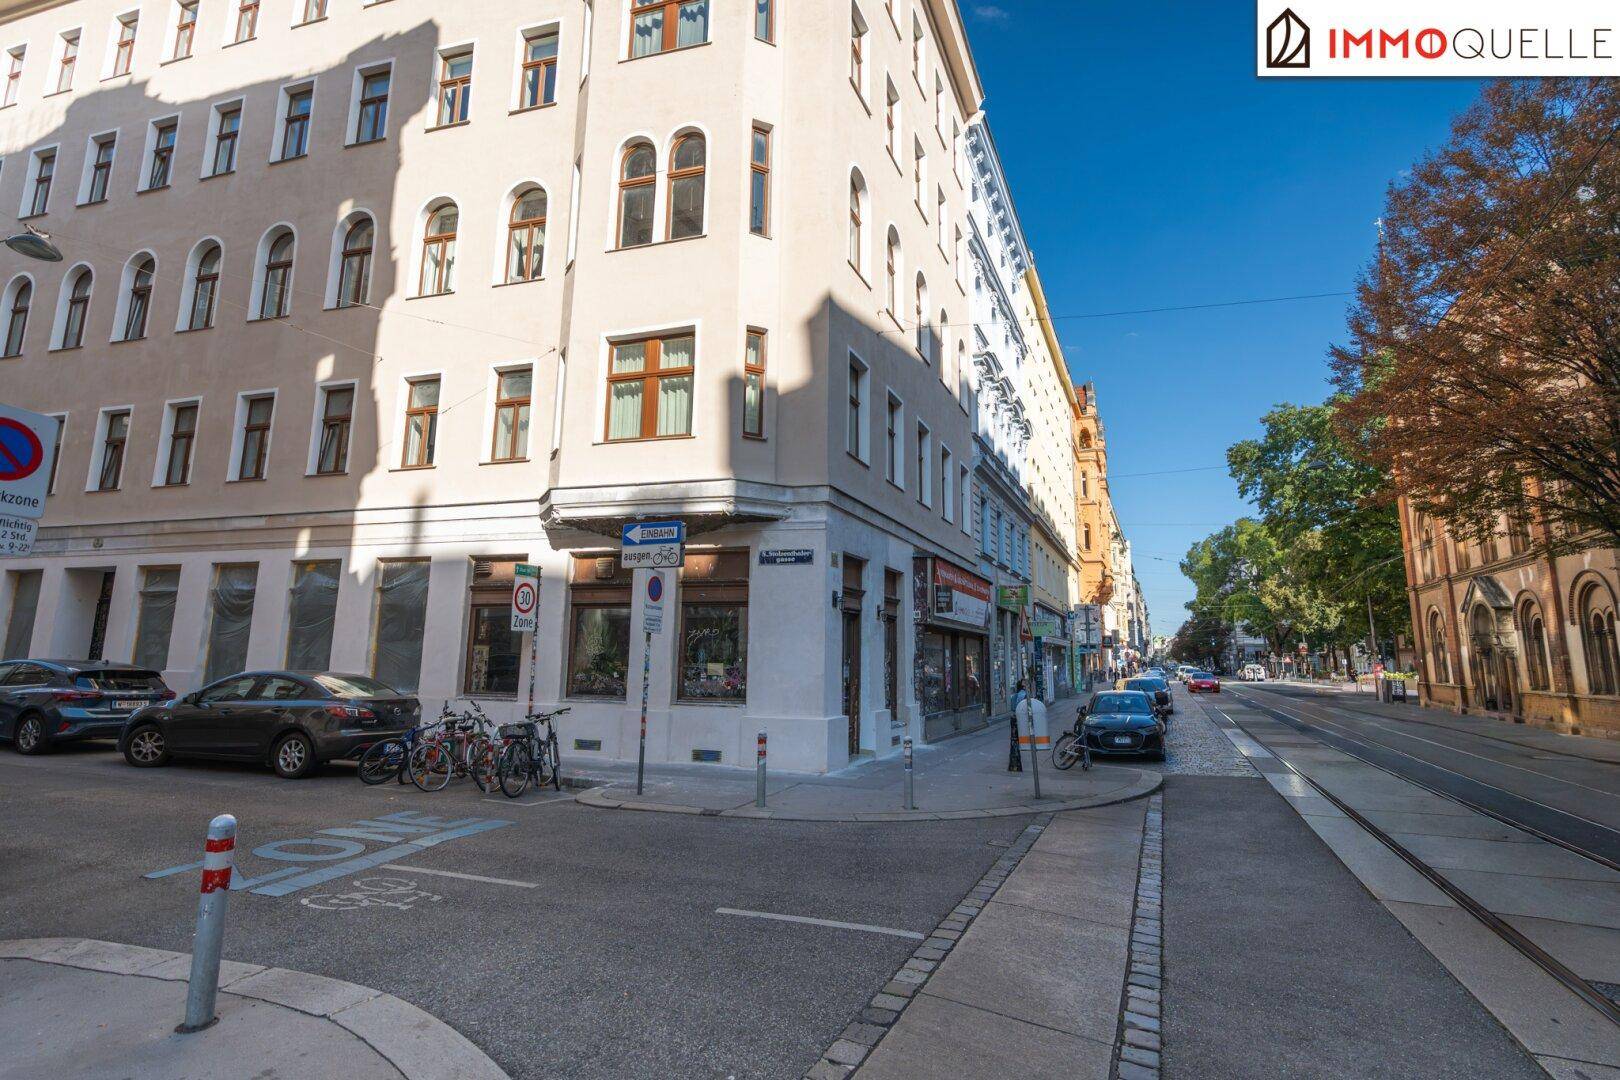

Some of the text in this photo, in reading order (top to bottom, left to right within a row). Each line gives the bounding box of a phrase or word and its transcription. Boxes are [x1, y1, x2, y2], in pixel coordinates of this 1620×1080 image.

[1, 530, 8, 539] 2
[641, 527, 675, 539] EINBAHN
[623, 552, 653, 563] ausgen.
[519, 590, 531, 606] 30
[513, 615, 534, 629] Zone
